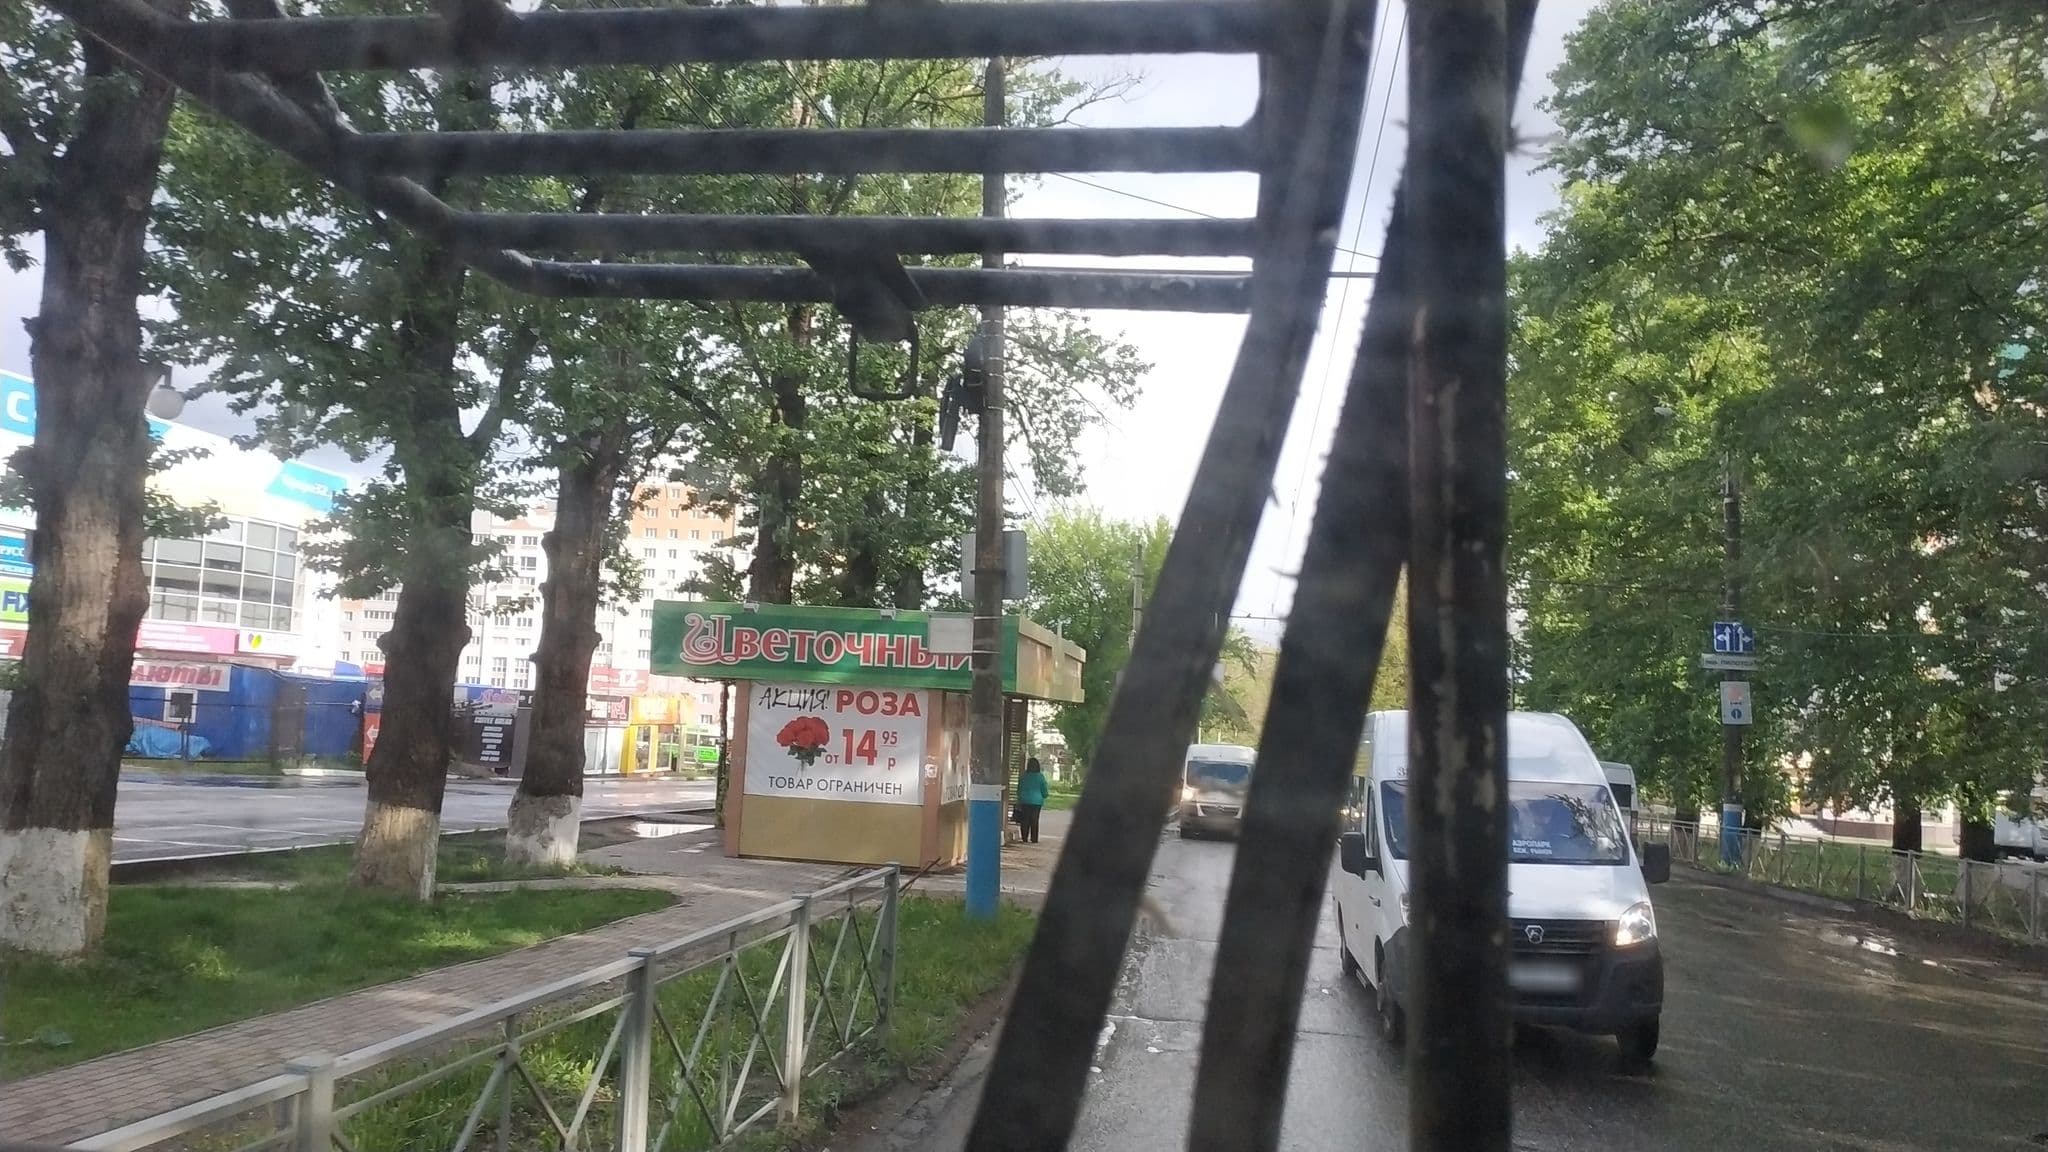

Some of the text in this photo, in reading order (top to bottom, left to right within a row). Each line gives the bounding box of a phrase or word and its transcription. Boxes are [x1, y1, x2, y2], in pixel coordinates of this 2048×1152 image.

[758, 687, 921, 717] АКЦИЯ! РОЗА
[842, 728, 878, 766] 14
[882, 730, 898, 745] 95
[768, 775, 902, 796] ТОВАР ОГРАНИЧЕН
